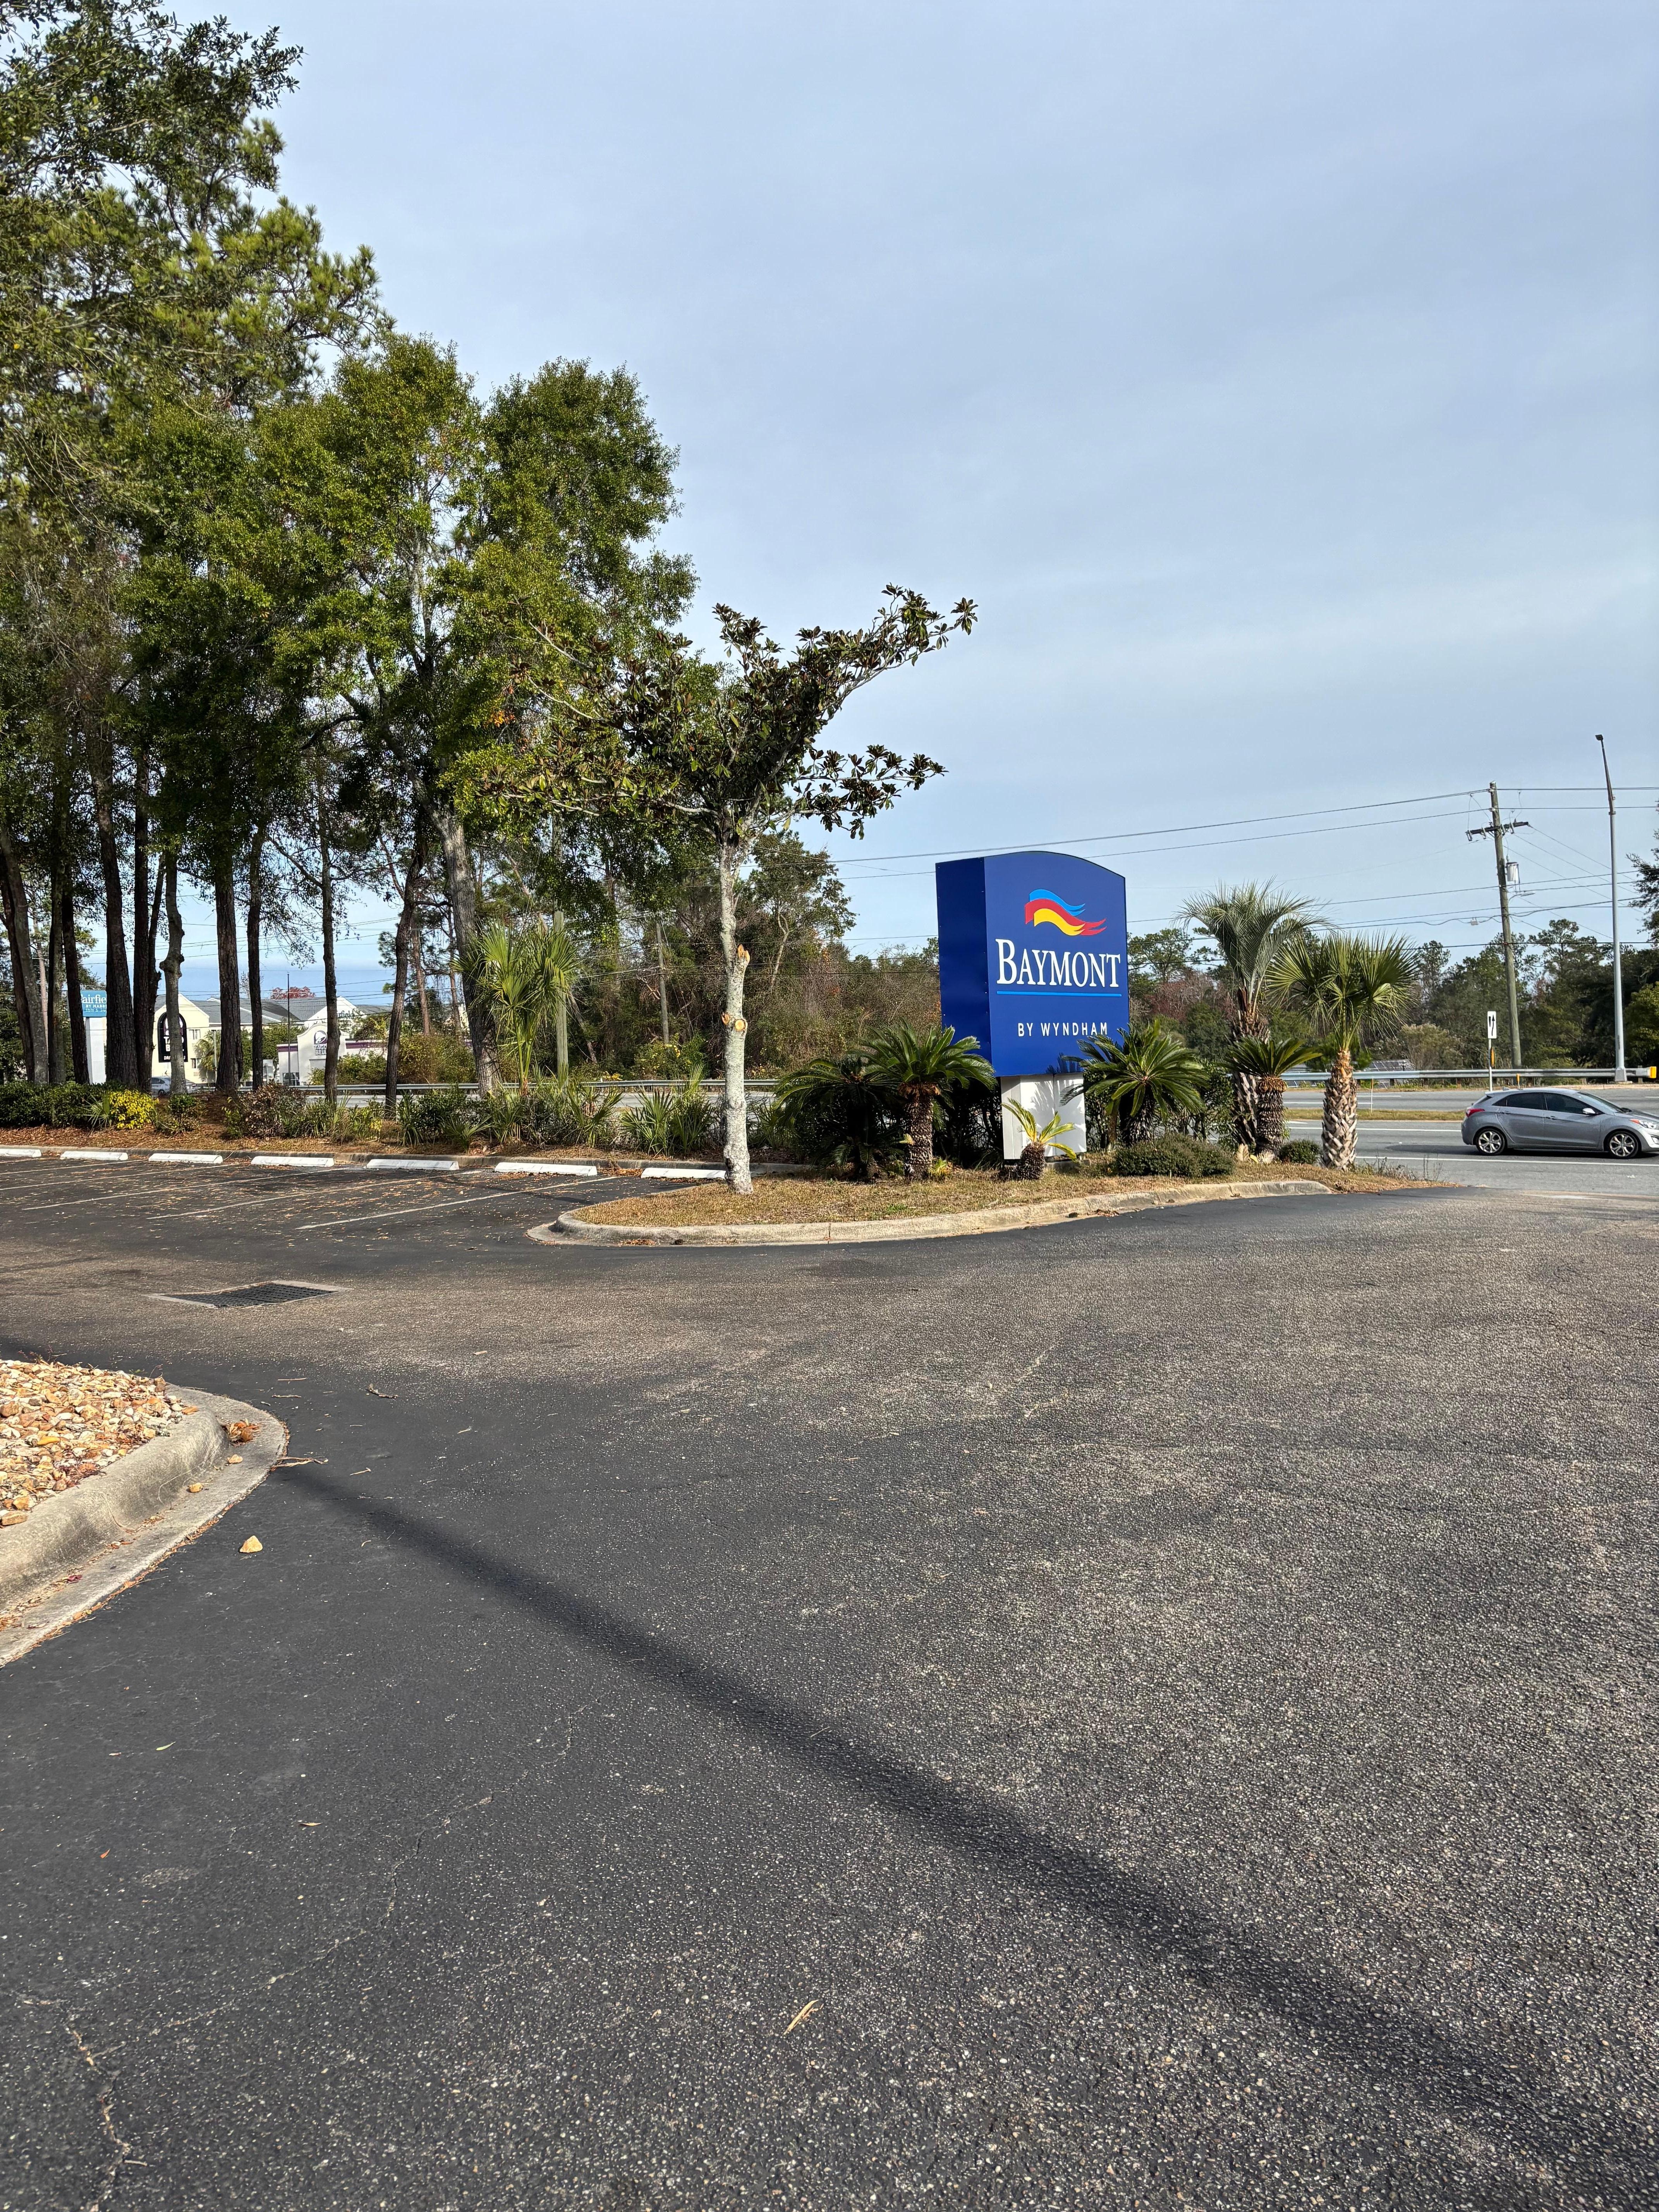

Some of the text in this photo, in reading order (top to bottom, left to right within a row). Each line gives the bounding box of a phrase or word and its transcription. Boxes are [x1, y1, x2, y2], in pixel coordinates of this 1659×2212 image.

[995, 939, 1121, 987] BAYMONT
[81, 994, 106, 1004] airfie
[1018, 1022, 1108, 1037] BY WYNDHAM
